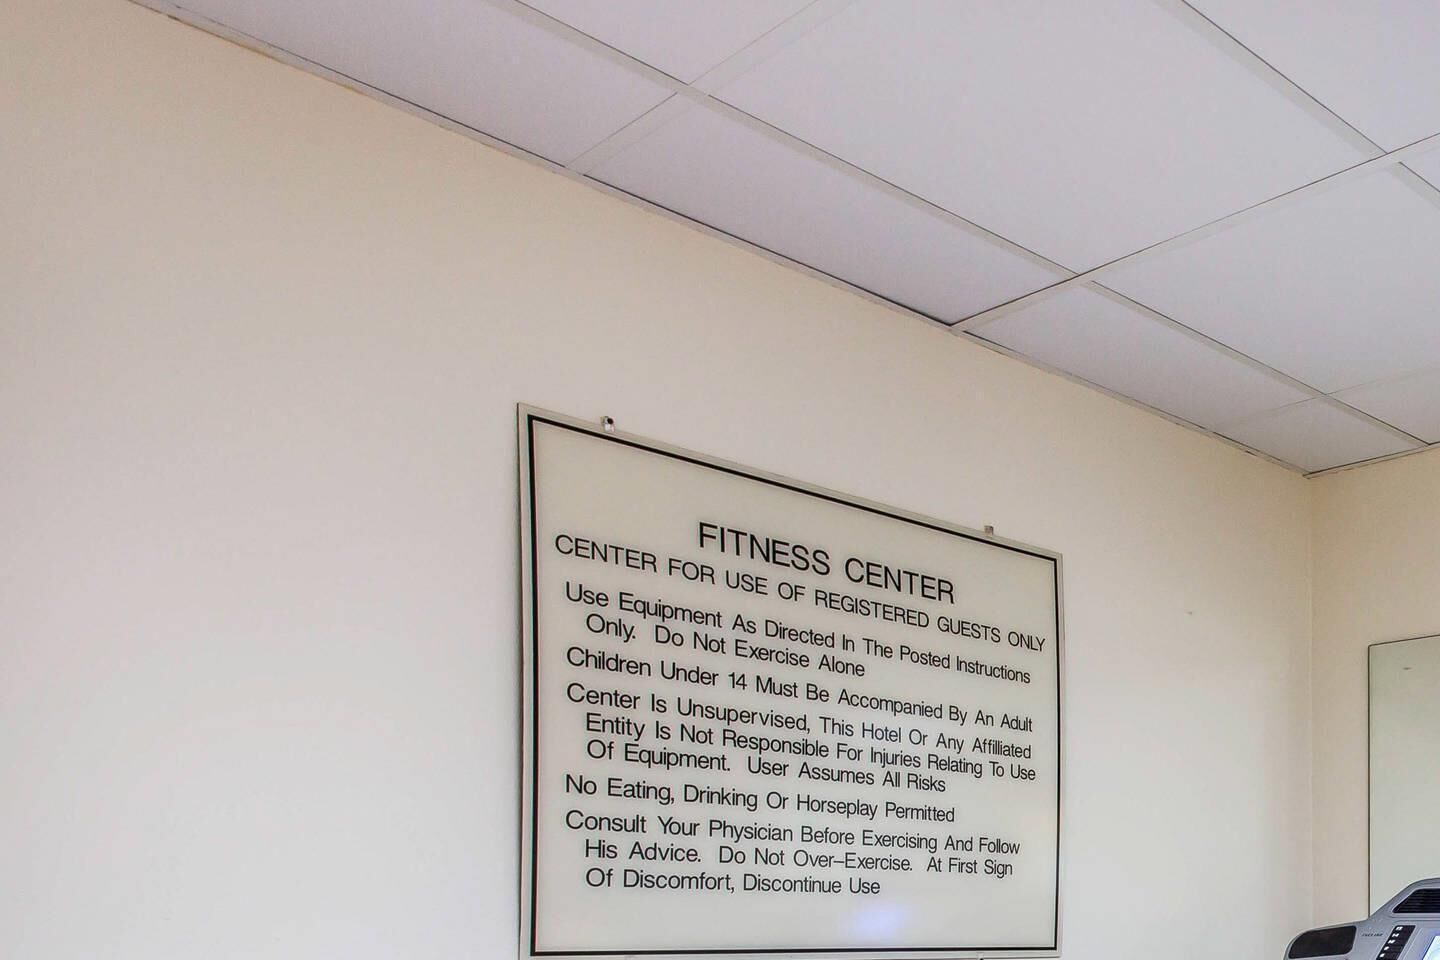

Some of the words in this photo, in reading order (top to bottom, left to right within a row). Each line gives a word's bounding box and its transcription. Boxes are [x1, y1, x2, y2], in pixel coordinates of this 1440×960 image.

[555, 535, 657, 573] CENTER
[669, 558, 715, 584] FOR
[726, 570, 768, 595] USE
[778, 582, 805, 601] OF
[815, 589, 929, 628] REGISTERED
[937, 616, 1000, 643] GUESTS
[1008, 632, 1045, 652] ONLY
[700, 522, 830, 575] FITNESS
[845, 558, 954, 604] CENTER
[566, 581, 609, 607] Use
[619, 592, 722, 628] Equipment
[732, 614, 756, 634] As
[765, 619, 834, 648] Directed
[843, 634, 855, 652] In
[862, 638, 893, 658] The
[900, 645, 950, 669] Posted
[957, 656, 1030, 684] Instructions
[586, 613, 635, 642] Only.
[655, 625, 684, 646] Do
[694, 632, 726, 654] Not
[735, 639, 809, 667] Exercise
[818, 654, 865, 677] Alone
[567, 647, 651, 676] Children
[661, 660, 719, 686] Under
[728, 672, 747, 690] 14
[756, 675, 798, 698] Must
[806, 683, 829, 702] Be
[838, 689, 942, 719] Accompanied
[949, 705, 967, 726] By
[975, 710, 994, 726] An
[1000, 714, 1032, 732] Adult
[567, 683, 640, 709] Center
[651, 694, 667, 713] Is
[678, 697, 810, 734] Unsupervised,
[819, 716, 854, 736] This
[862, 722, 901, 743] Hotel
[909, 729, 928, 745] Or
[936, 733, 964, 754] Any
[586, 712, 645, 741] Entity
[656, 721, 671, 740] Is
[681, 724, 714, 745] Not
[723, 729, 829, 758] Responsible
[837, 743, 863, 761] For
[871, 747, 921, 768] Injuries
[928, 754, 982, 778] Relating
[989, 761, 1004, 777] To
[1011, 763, 1036, 781] Use
[587, 739, 614, 760] Of
[625, 743, 730, 771] Equipment.
[748, 756, 789, 776] User
[798, 762, 874, 785] Assumes
[882, 771, 900, 787] All
[908, 773, 945, 792] Risks
[566, 774, 597, 795] No
[608, 778, 674, 805] Eating,
[684, 784, 757, 812] Drinking
[766, 792, 789, 809] Or
[797, 794, 878, 820] Horseplay
[886, 802, 954, 822] Permitted
[566, 810, 646, 833] Consult
[658, 816, 700, 836] Your
[710, 819, 792, 842] Physician
[801, 826, 855, 845] Before
[863, 830, 937, 853] Exercising
[944, 835, 973, 851] And
[979, 837, 1020, 854] Follow
[585, 839, 617, 859] His
[629, 841, 701, 862] Advice.
[720, 846, 746, 864] Do
[755, 848, 784, 866] Not
[927, 856, 942, 872] At
[949, 857, 978, 874] First
[984, 859, 1012, 878] Sign
[586, 868, 613, 887] Of
[624, 869, 734, 893] Discomfort,
[744, 874, 841, 893] Discontinue
[850, 878, 880, 894] Use
